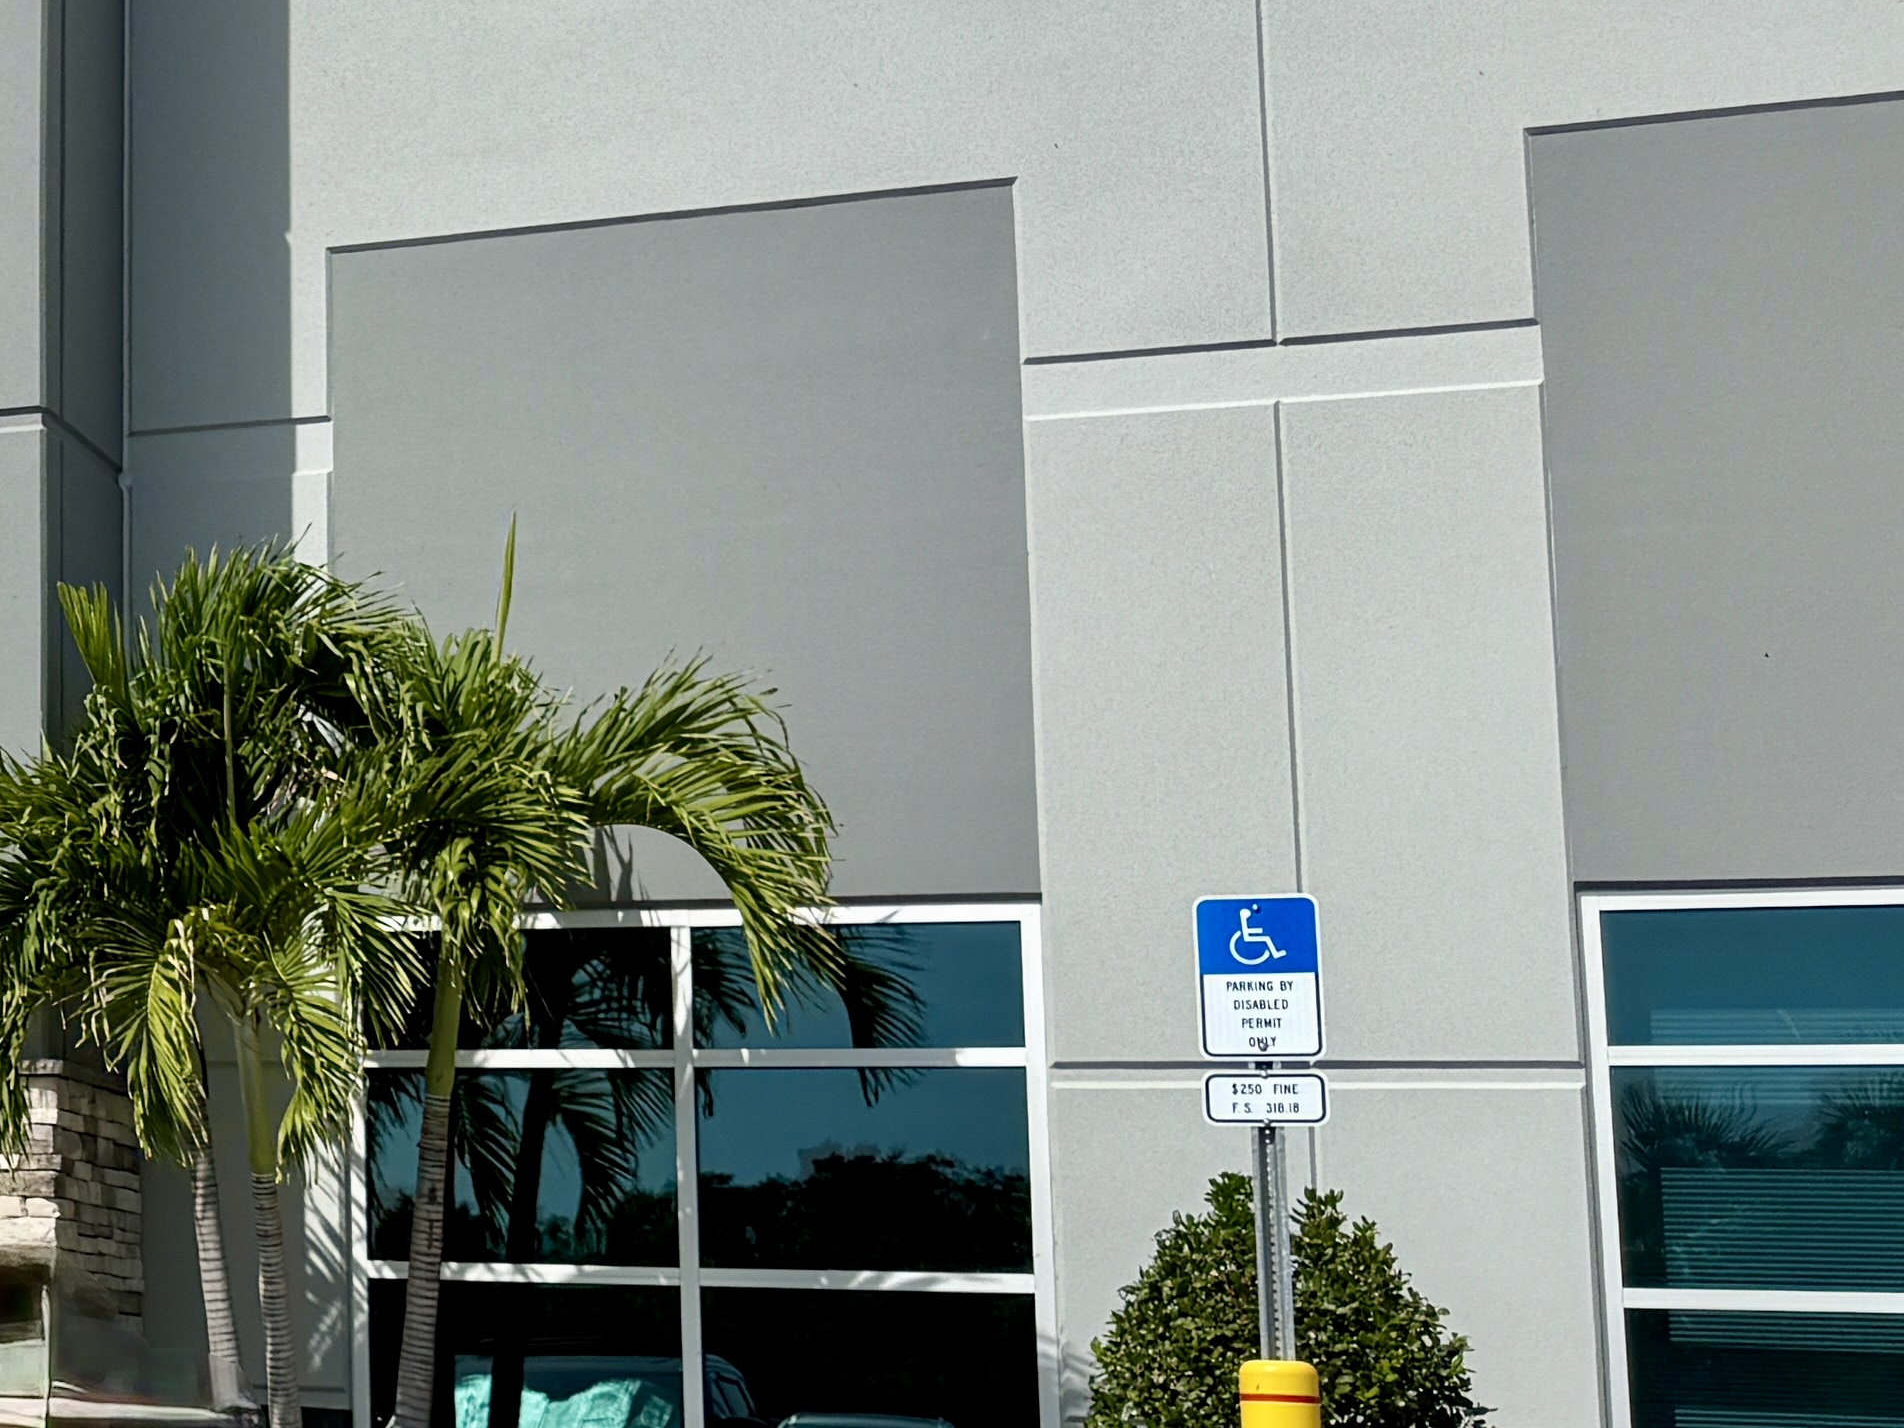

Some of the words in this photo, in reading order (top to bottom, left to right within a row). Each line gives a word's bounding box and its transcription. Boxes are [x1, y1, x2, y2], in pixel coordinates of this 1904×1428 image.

[1226, 980, 1274, 992] PARKING
[1280, 980, 1293, 992] BY
[1233, 998, 1289, 1010] DISABLED
[1241, 1017, 1282, 1029] PERMIT
[1232, 1083, 1263, 1095] $250
[1273, 1083, 1299, 1095] FINE
